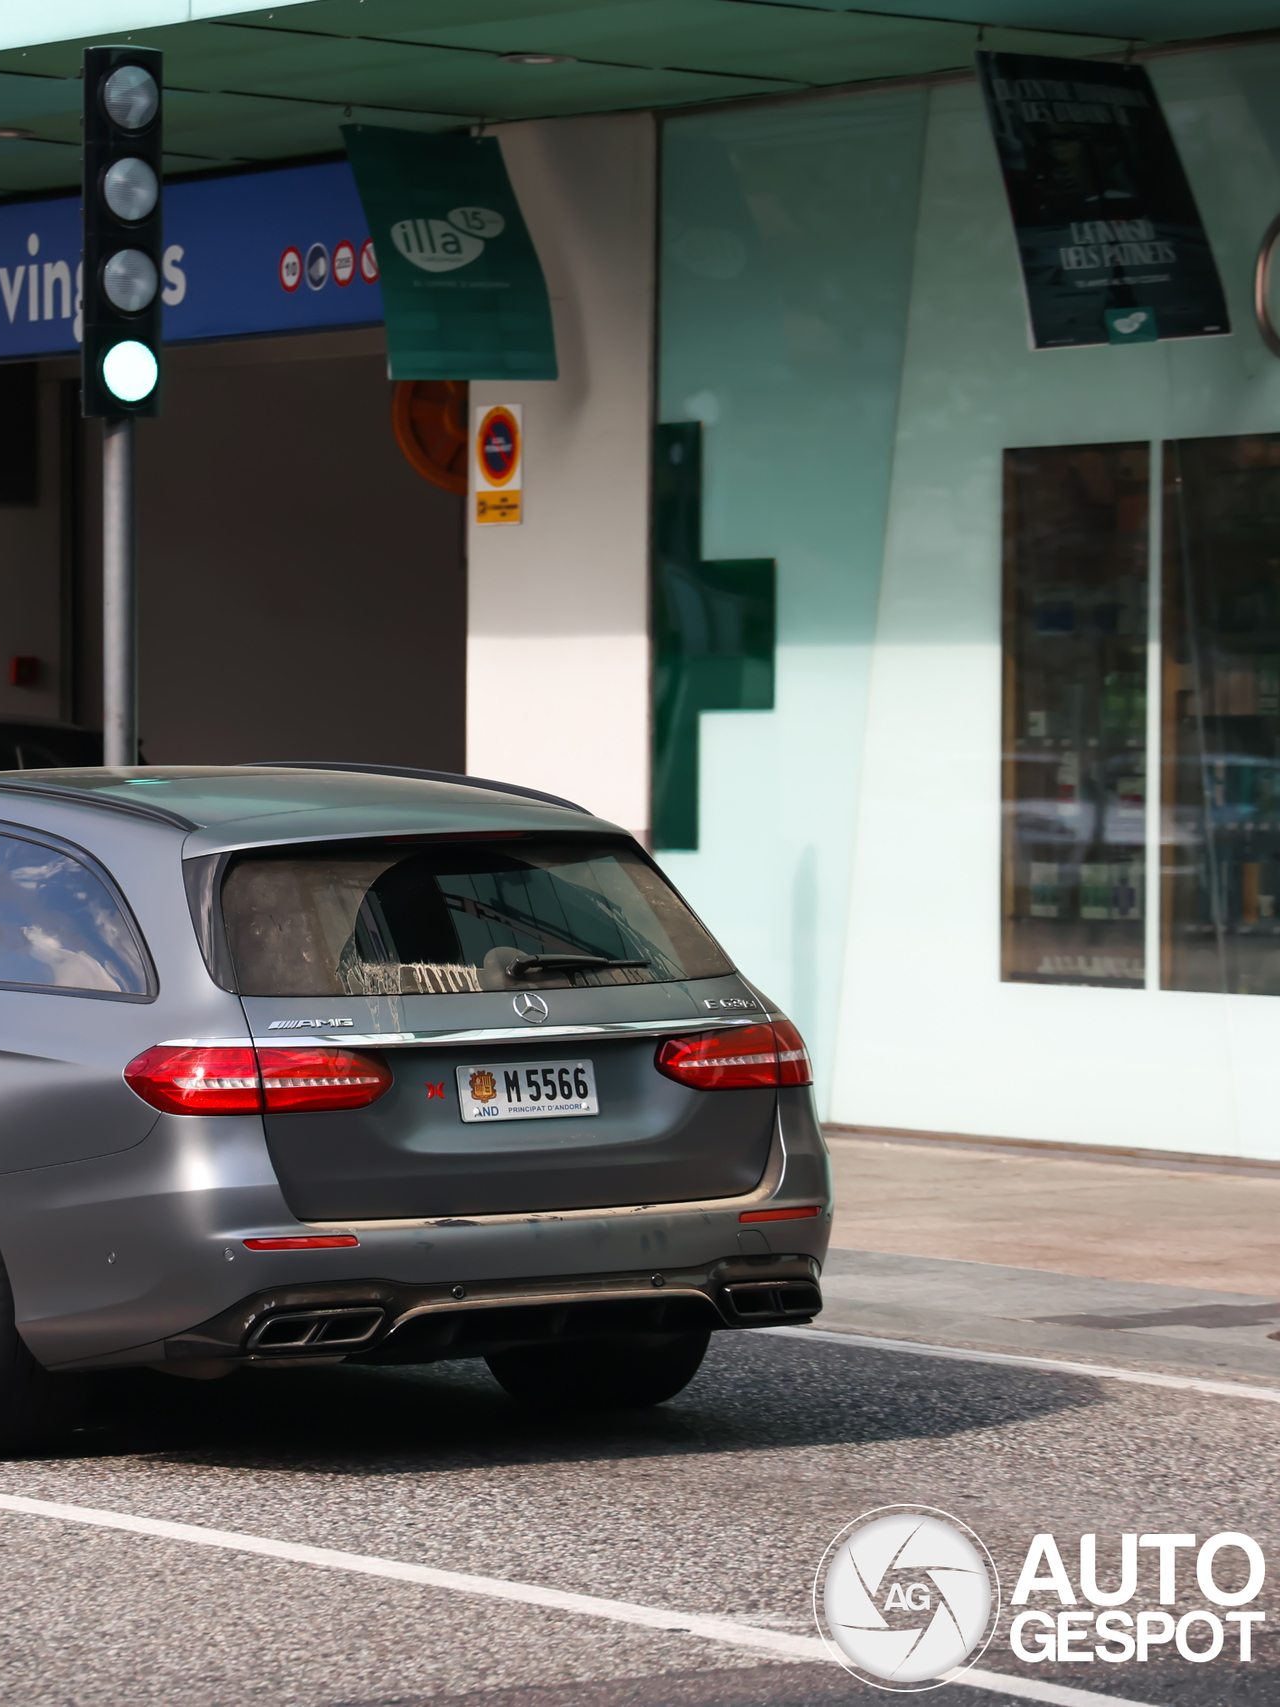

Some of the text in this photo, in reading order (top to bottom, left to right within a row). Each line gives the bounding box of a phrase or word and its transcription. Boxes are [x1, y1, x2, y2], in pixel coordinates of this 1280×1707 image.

[460, 210, 486, 230] 15
[400, 219, 463, 255] illa
[296, 1018, 354, 1028] AMG
[504, 1067, 589, 1103] M 5566
[508, 1105, 546, 1113] PRINCIPAT
